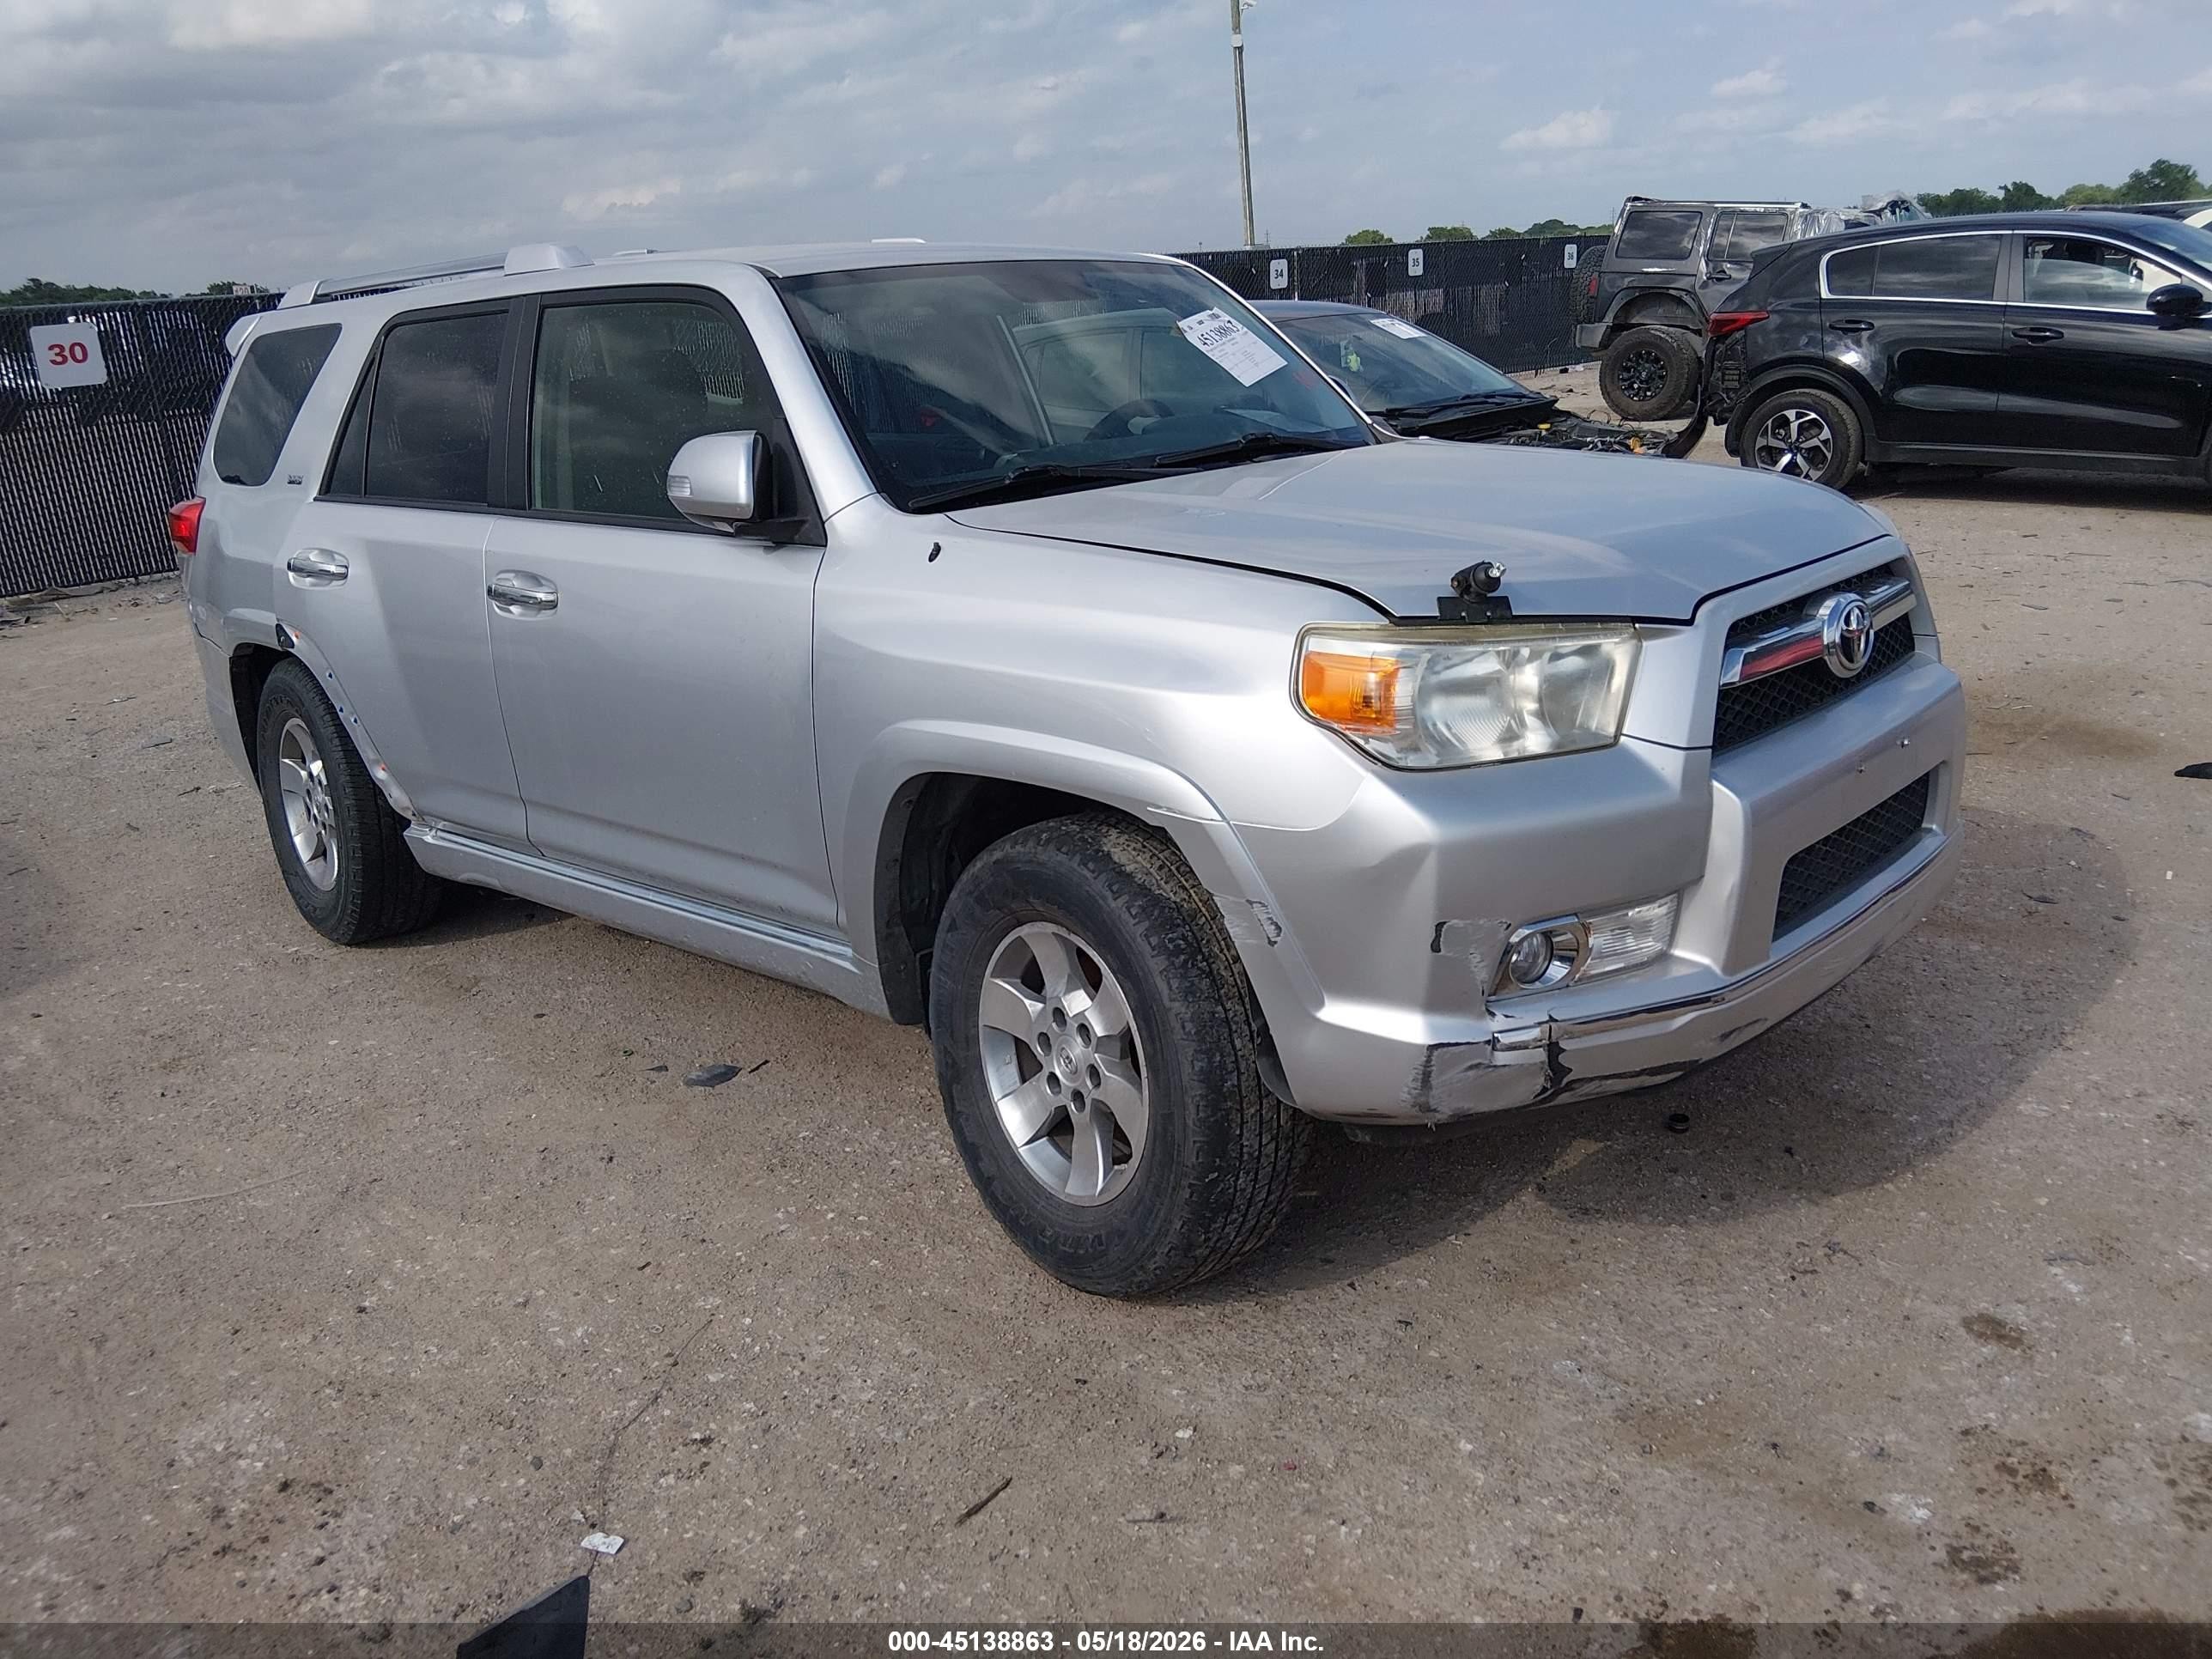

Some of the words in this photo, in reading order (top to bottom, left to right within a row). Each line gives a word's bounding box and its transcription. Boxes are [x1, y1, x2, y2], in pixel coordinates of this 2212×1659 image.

[1412, 258, 1420, 268] 35
[1274, 268, 1284, 279] 34
[1197, 319, 1240, 347] 45138863
[48, 342, 88, 366] 30
